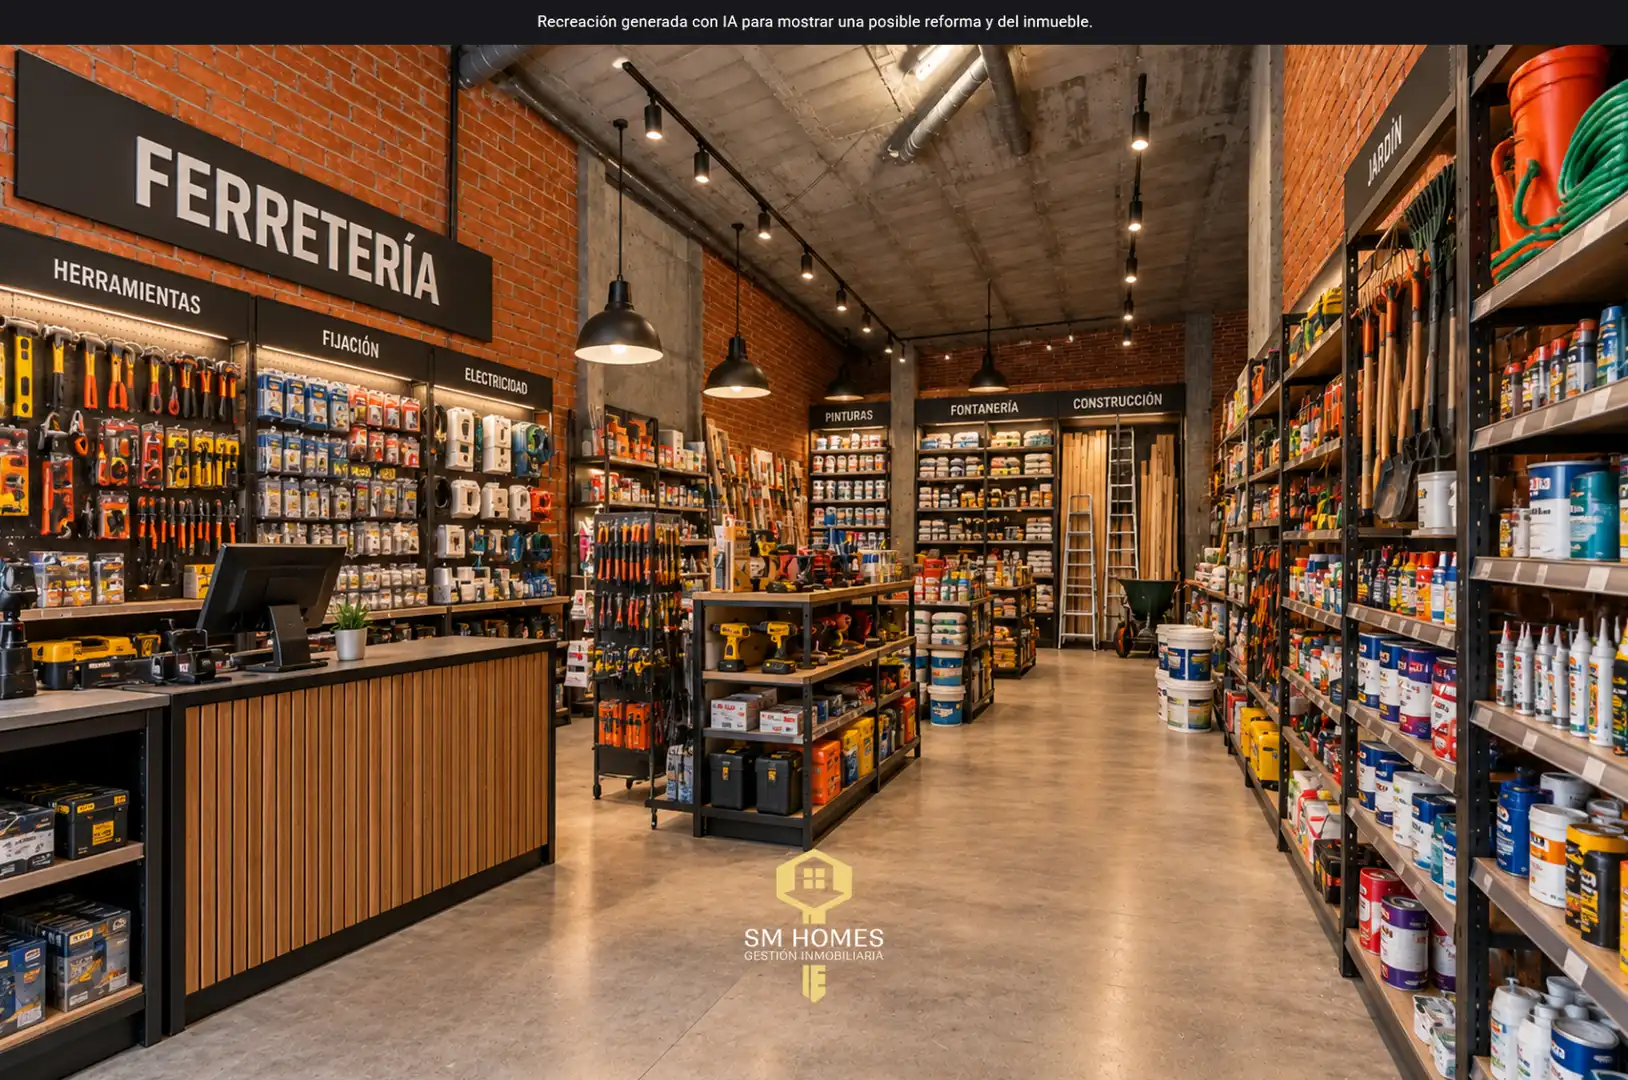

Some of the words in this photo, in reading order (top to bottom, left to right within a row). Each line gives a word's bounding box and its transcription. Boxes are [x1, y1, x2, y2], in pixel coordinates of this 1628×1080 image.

[135, 136, 440, 306] FERRETERÍA
[53, 258, 201, 315] HERRAMIENTAS
[322, 329, 379, 359] FIJACIÓN
[951, 399, 1019, 416] FONTANERÍA
[1073, 392, 1163, 410] CONSTRUCCIÓN
[825, 410, 874, 423] PINTURAS
